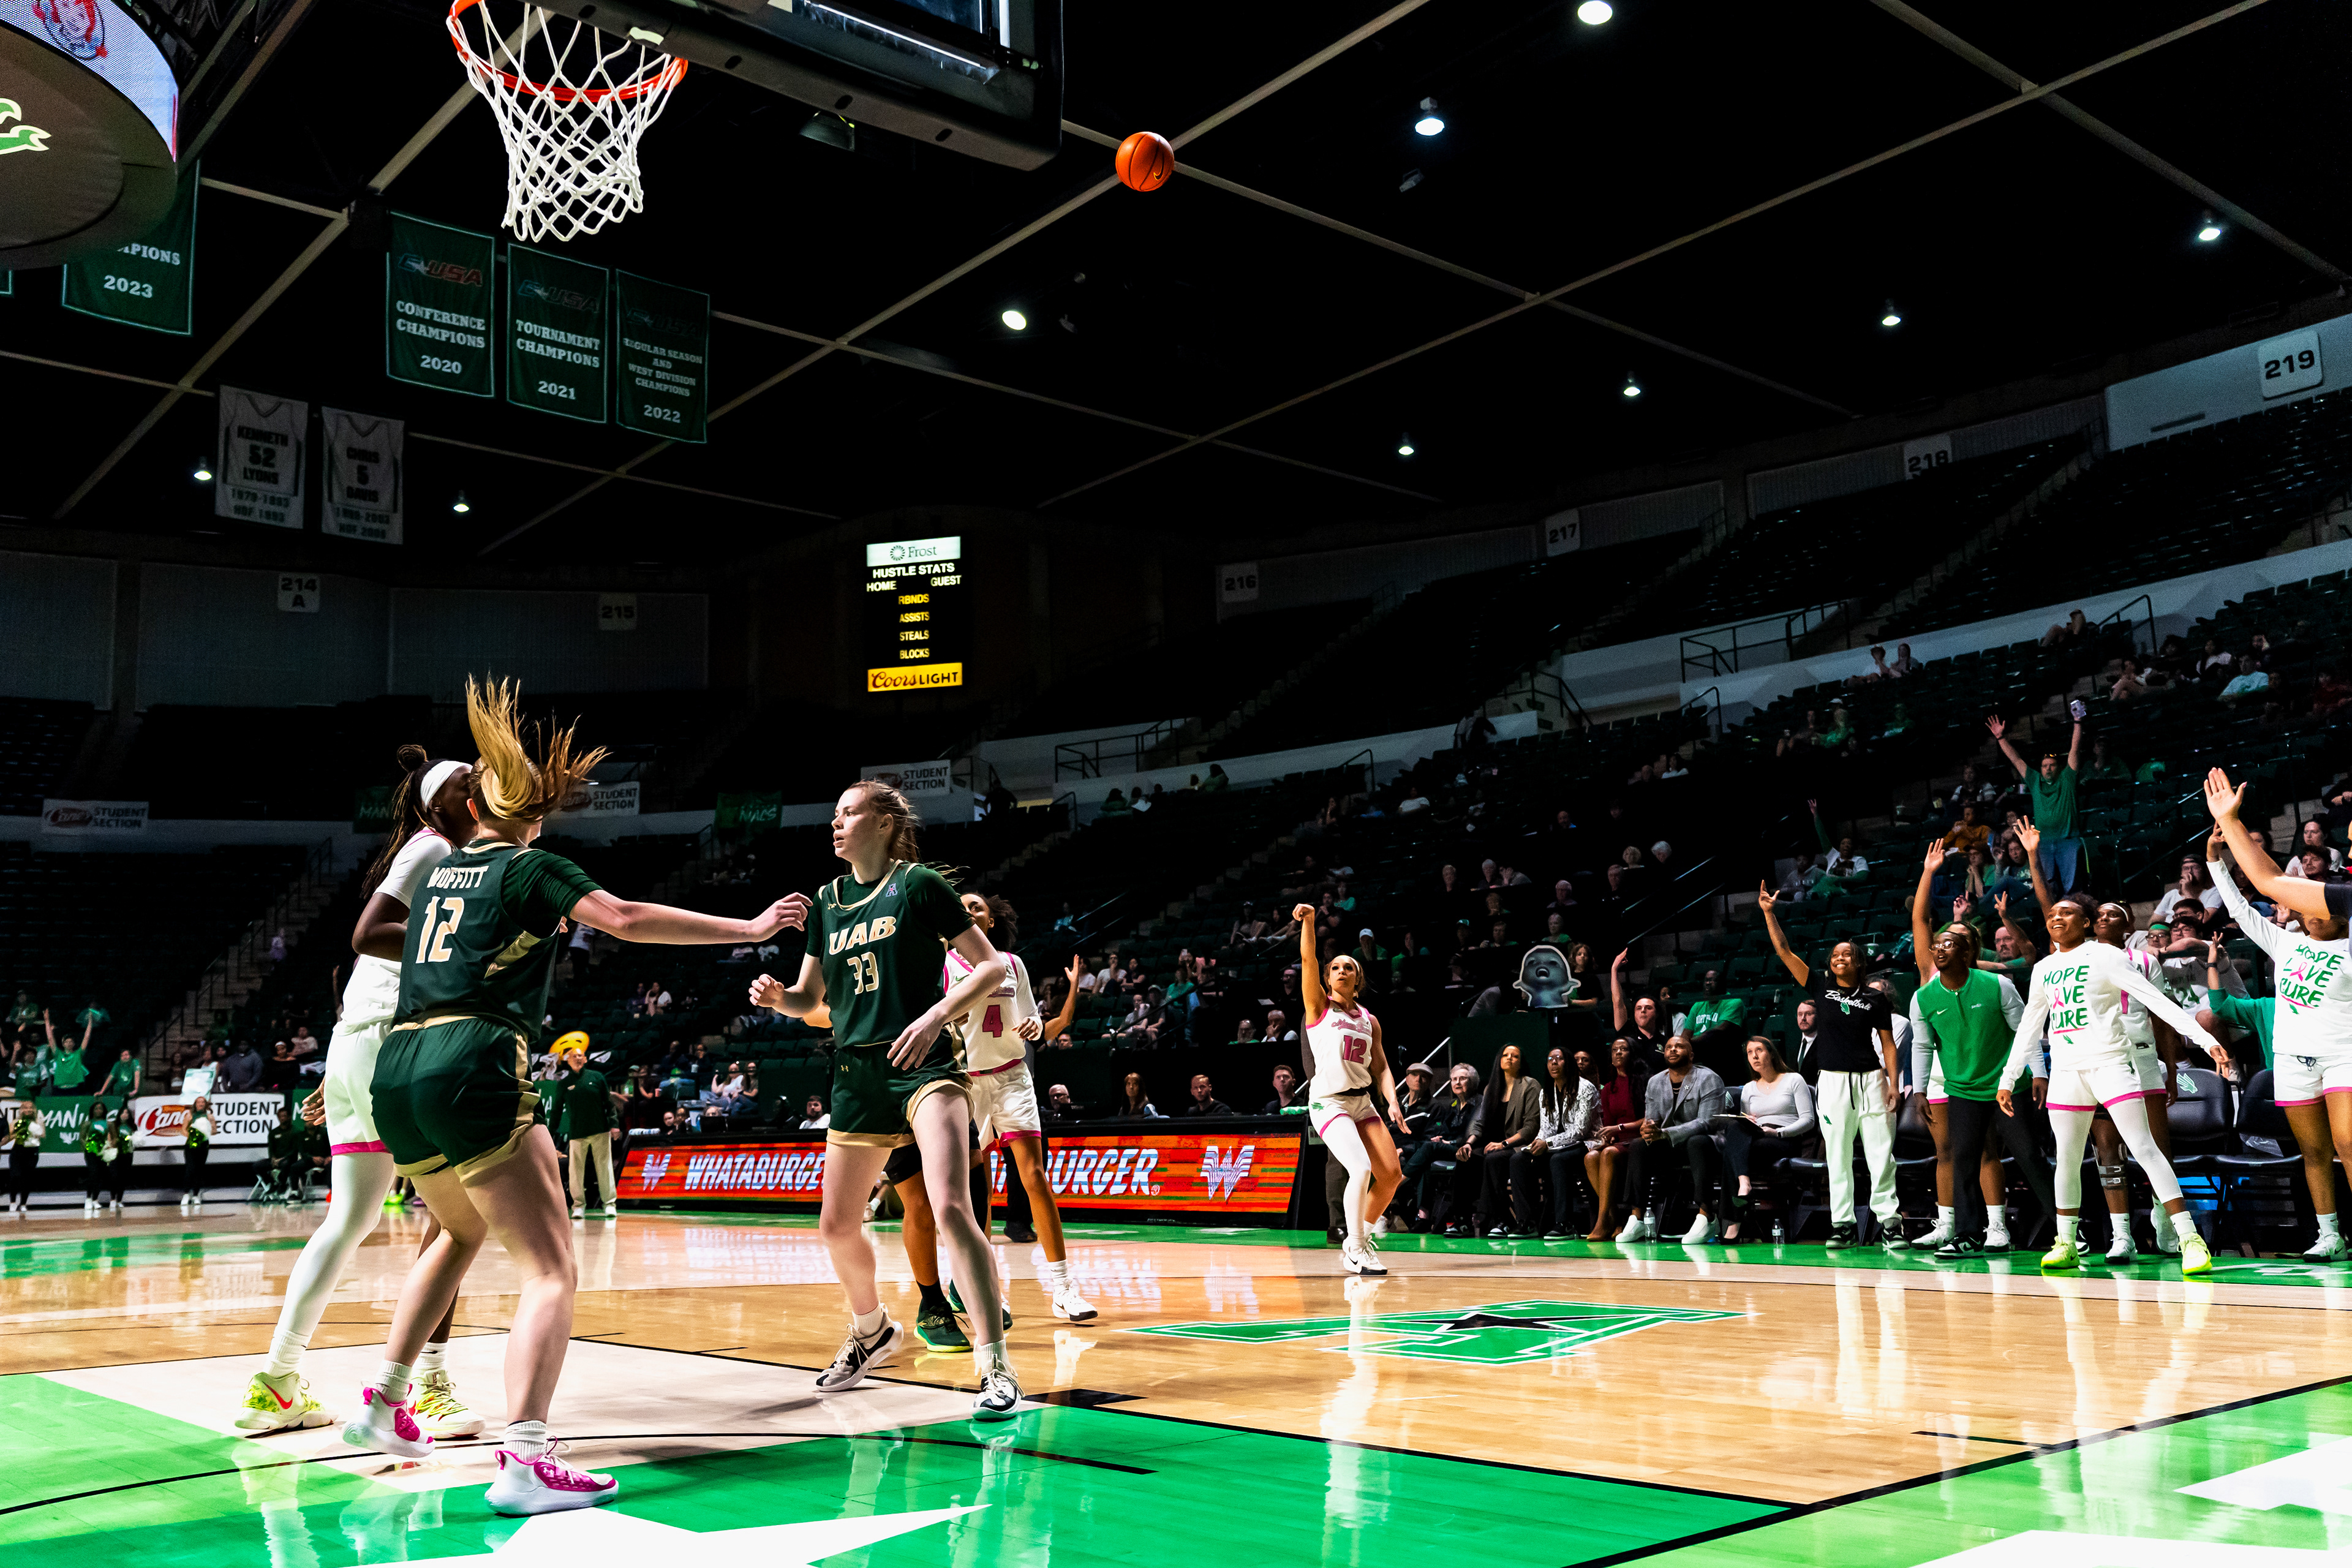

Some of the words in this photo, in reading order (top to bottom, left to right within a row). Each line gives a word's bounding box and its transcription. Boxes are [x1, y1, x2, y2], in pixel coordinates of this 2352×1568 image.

[104, 274, 153, 298] 2023
[396, 300, 486, 331] CONFERENCE
[396, 318, 486, 349] CHAMPIONS
[516, 319, 600, 350] TOURNAMENT
[516, 338, 600, 368] CHAMPIONS
[667, 349, 703, 364] SEASON
[420, 355, 462, 374] 2020
[652, 358, 673, 369] AND
[2265, 350, 2315, 380] 219
[628, 363, 654, 377] WEST
[655, 371, 696, 386] DIVISION
[537, 380, 576, 400] 2021
[635, 377, 690, 397] CHAMPIONS
[644, 404, 681, 423] 2022
[237, 426, 288, 447] KENNETH
[249, 445, 276, 468] 52
[347, 447, 379, 463] CHRIS
[1909, 450, 1948, 472] 218
[243, 467, 278, 484] LYONS
[357, 465, 369, 484] 5
[347, 486, 379, 502] DAVIS
[1550, 524, 1577, 544] 217
[908, 546, 937, 558] Frost
[873, 565, 916, 578] HUSTLE
[918, 563, 955, 575] STATS
[282, 578, 316, 592] 214
[867, 581, 897, 592] HOME
[930, 575, 962, 587] GUEST
[1225, 575, 1256, 591] 216
[293, 594, 304, 608] A
[899, 594, 930, 605] RBNDS
[602, 606, 634, 618] 215
[899, 611, 930, 623] ASSISTS
[900, 630, 930, 641] STEALS
[900, 648, 930, 659] BLOCKS
[872, 672, 918, 688] Coors
[919, 671, 959, 685] LIGHT
[903, 767, 949, 779] STUDENT
[903, 778, 945, 790] SECTION
[593, 788, 637, 799] STUDENT
[94, 807, 146, 816] STUDENT
[593, 800, 635, 810] SECTION
[93, 818, 141, 827] SECTION
[415, 895, 465, 963] 12
[829, 916, 896, 955] UAB
[846, 951, 879, 995] 33
[2043, 965, 2089, 987] HOPE
[2280, 978, 2324, 1008] CURE
[982, 1004, 1003, 1038] 4
[1343, 1035, 1367, 1065] 12
[215, 1120, 273, 1134] ECTION
[684, 1152, 825, 1191] WHATABURGE
